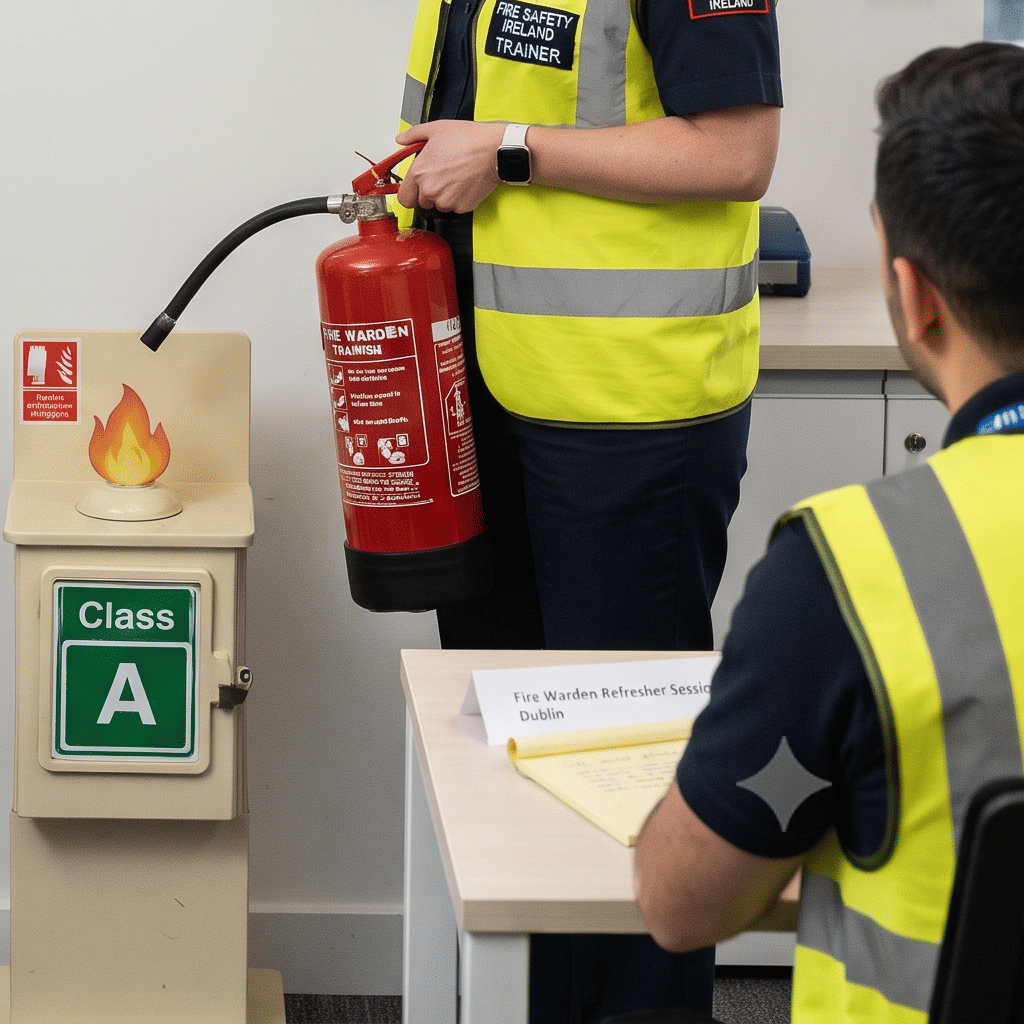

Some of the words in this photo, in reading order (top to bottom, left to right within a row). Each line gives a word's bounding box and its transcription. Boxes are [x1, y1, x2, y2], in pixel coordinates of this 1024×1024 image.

[496, 2, 521, 19] FIRE
[522, 7, 574, 29] SAFETY
[501, 18, 555, 42] IRELAND
[496, 36, 561, 64] TRAINER
[344, 325, 409, 342] WARDEN
[79, 601, 174, 630] Class
[97, 663, 156, 724] A
[513, 692, 539, 703] Fire
[543, 687, 598, 702] Warden
[601, 684, 666, 699] Refresher
[670, 681, 711, 696] Sessio
[519, 708, 565, 722] Dublin
